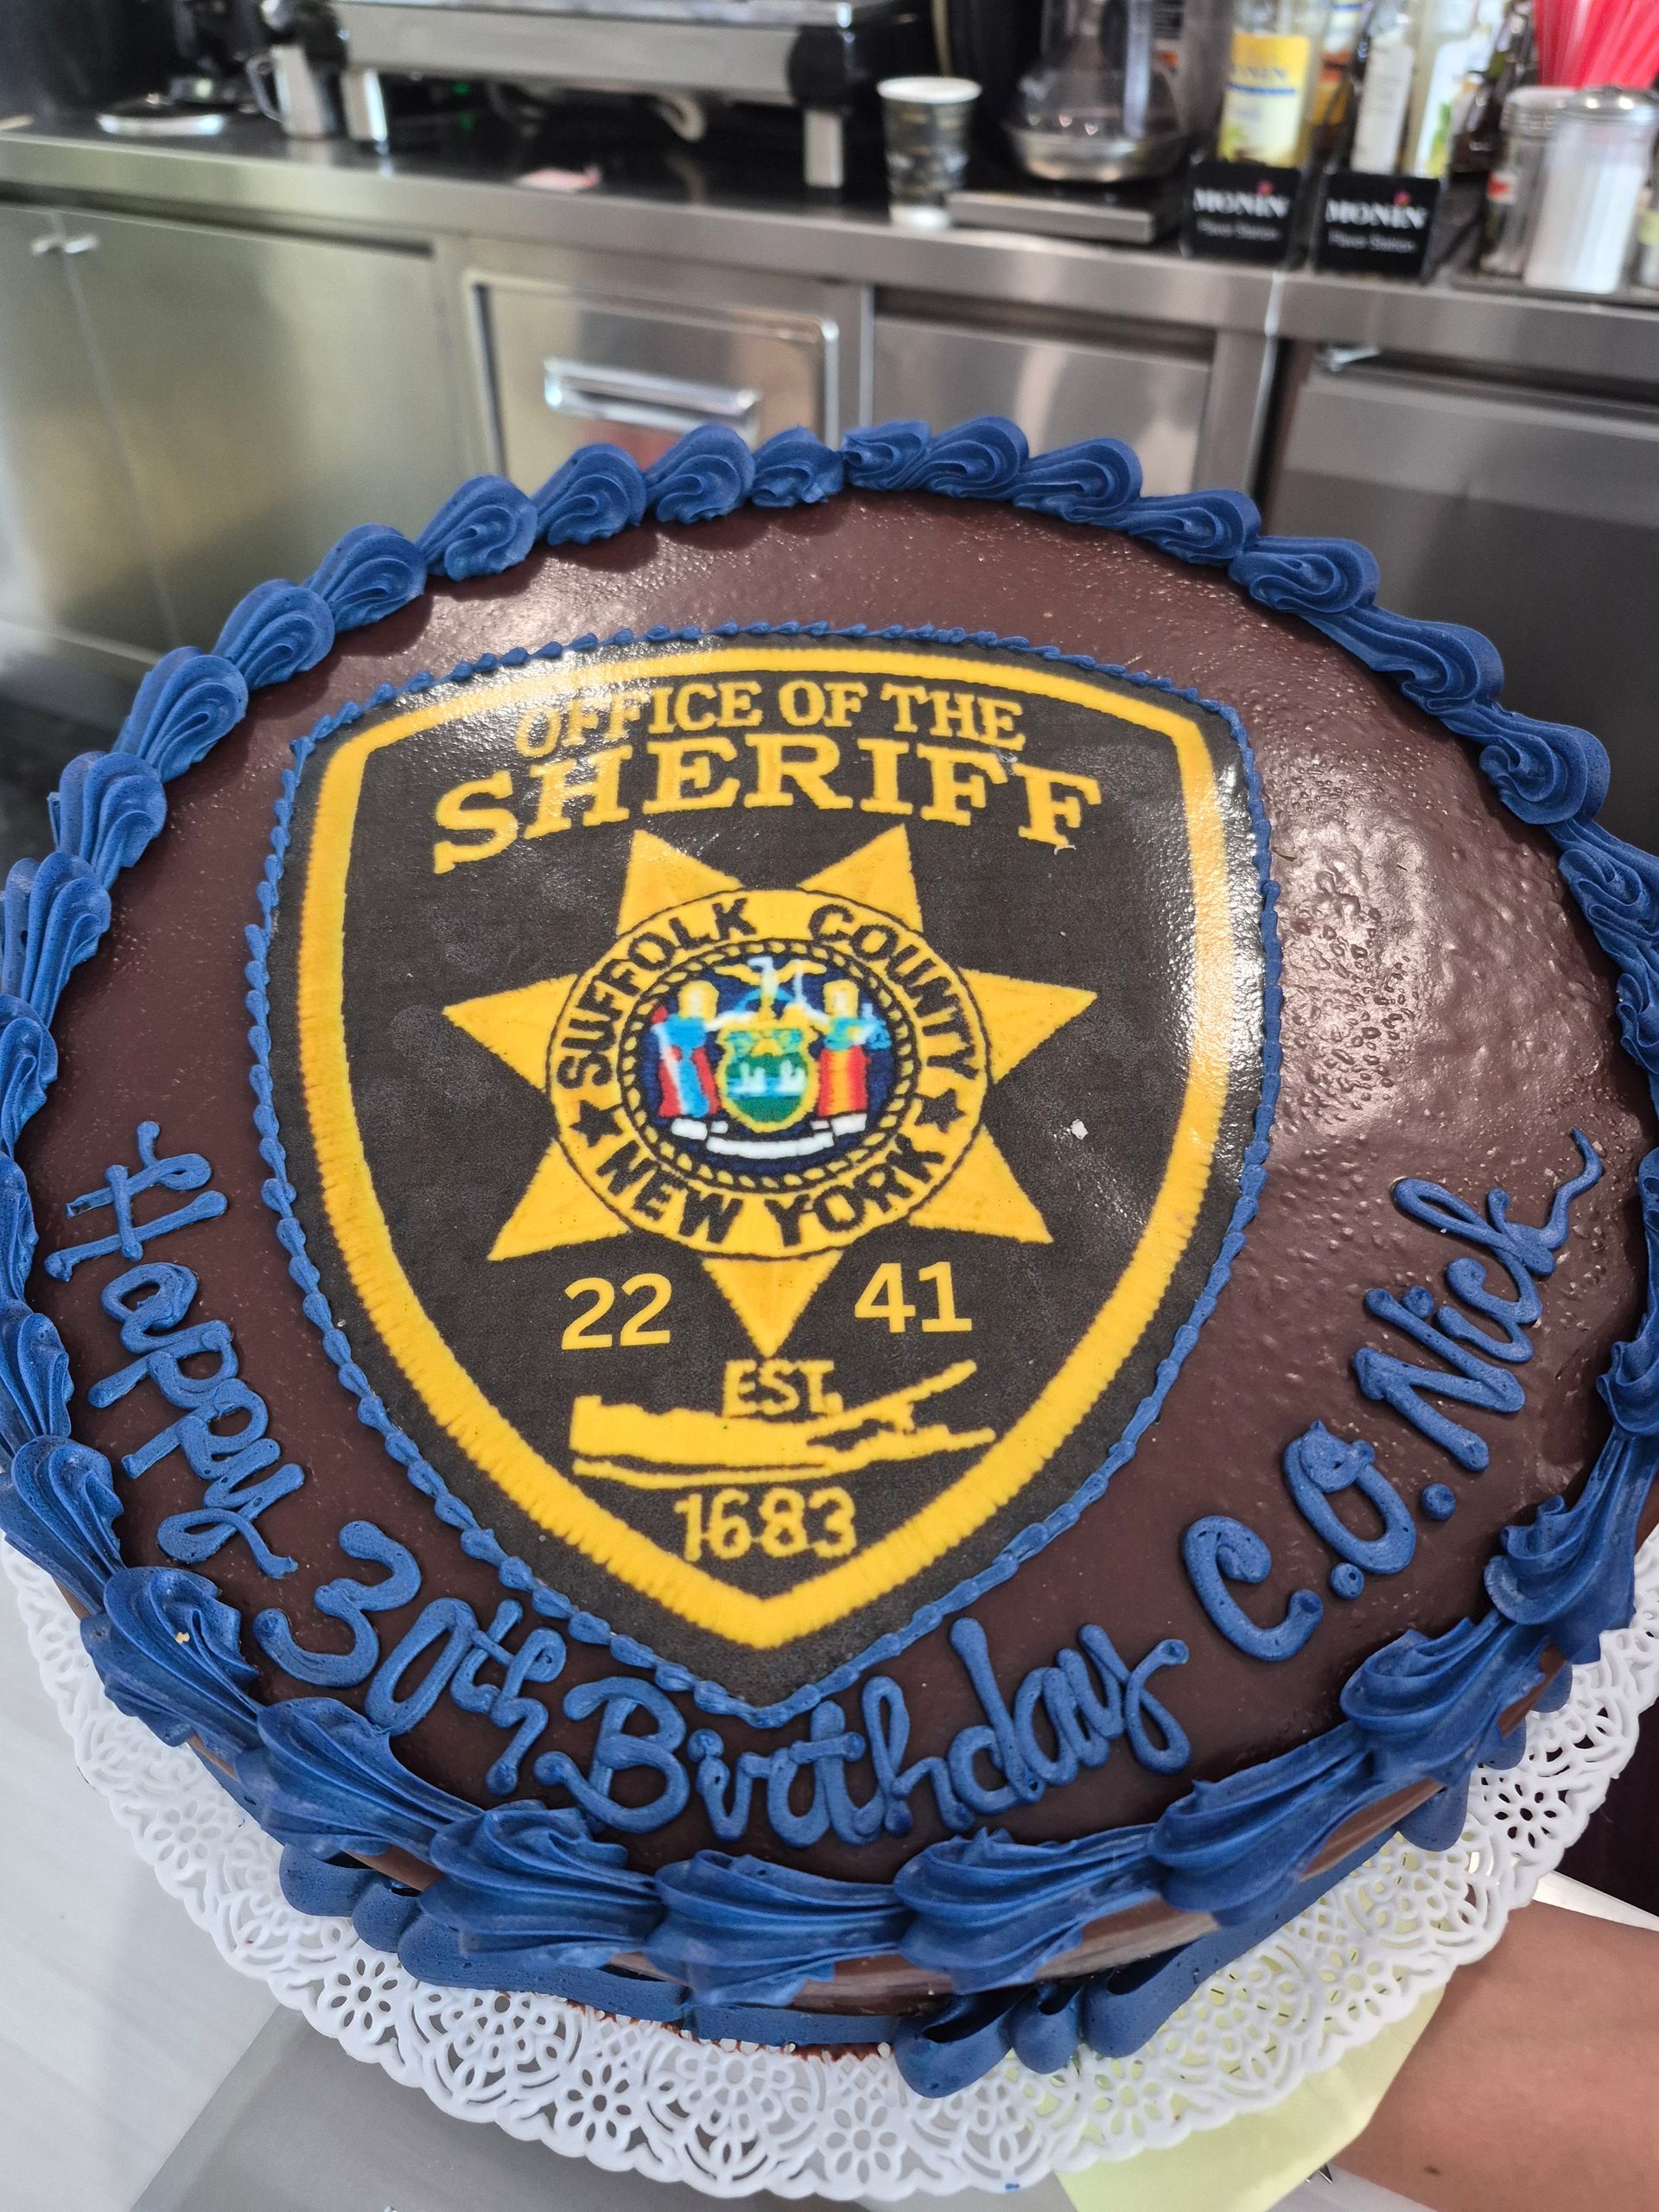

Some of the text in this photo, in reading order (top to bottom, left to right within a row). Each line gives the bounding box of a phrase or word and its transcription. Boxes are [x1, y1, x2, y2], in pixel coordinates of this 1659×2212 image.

[1193, 187, 1288, 219] MONIN
[1325, 198, 1427, 229] MONIN
[518, 683, 1027, 757] OFFICE OF THE
[432, 733, 1103, 874] SHERIFF
[556, 897, 979, 1090] SUFFOLK COUNTY
[596, 1135, 945, 1247] NEW YORK
[562, 1273, 672, 1350] 22
[854, 1261, 972, 1333] 41
[43, 1121, 299, 1580] Happy
[534, 1617, 1190, 1851] Birthday
[674, 1488, 857, 1560] 1683
